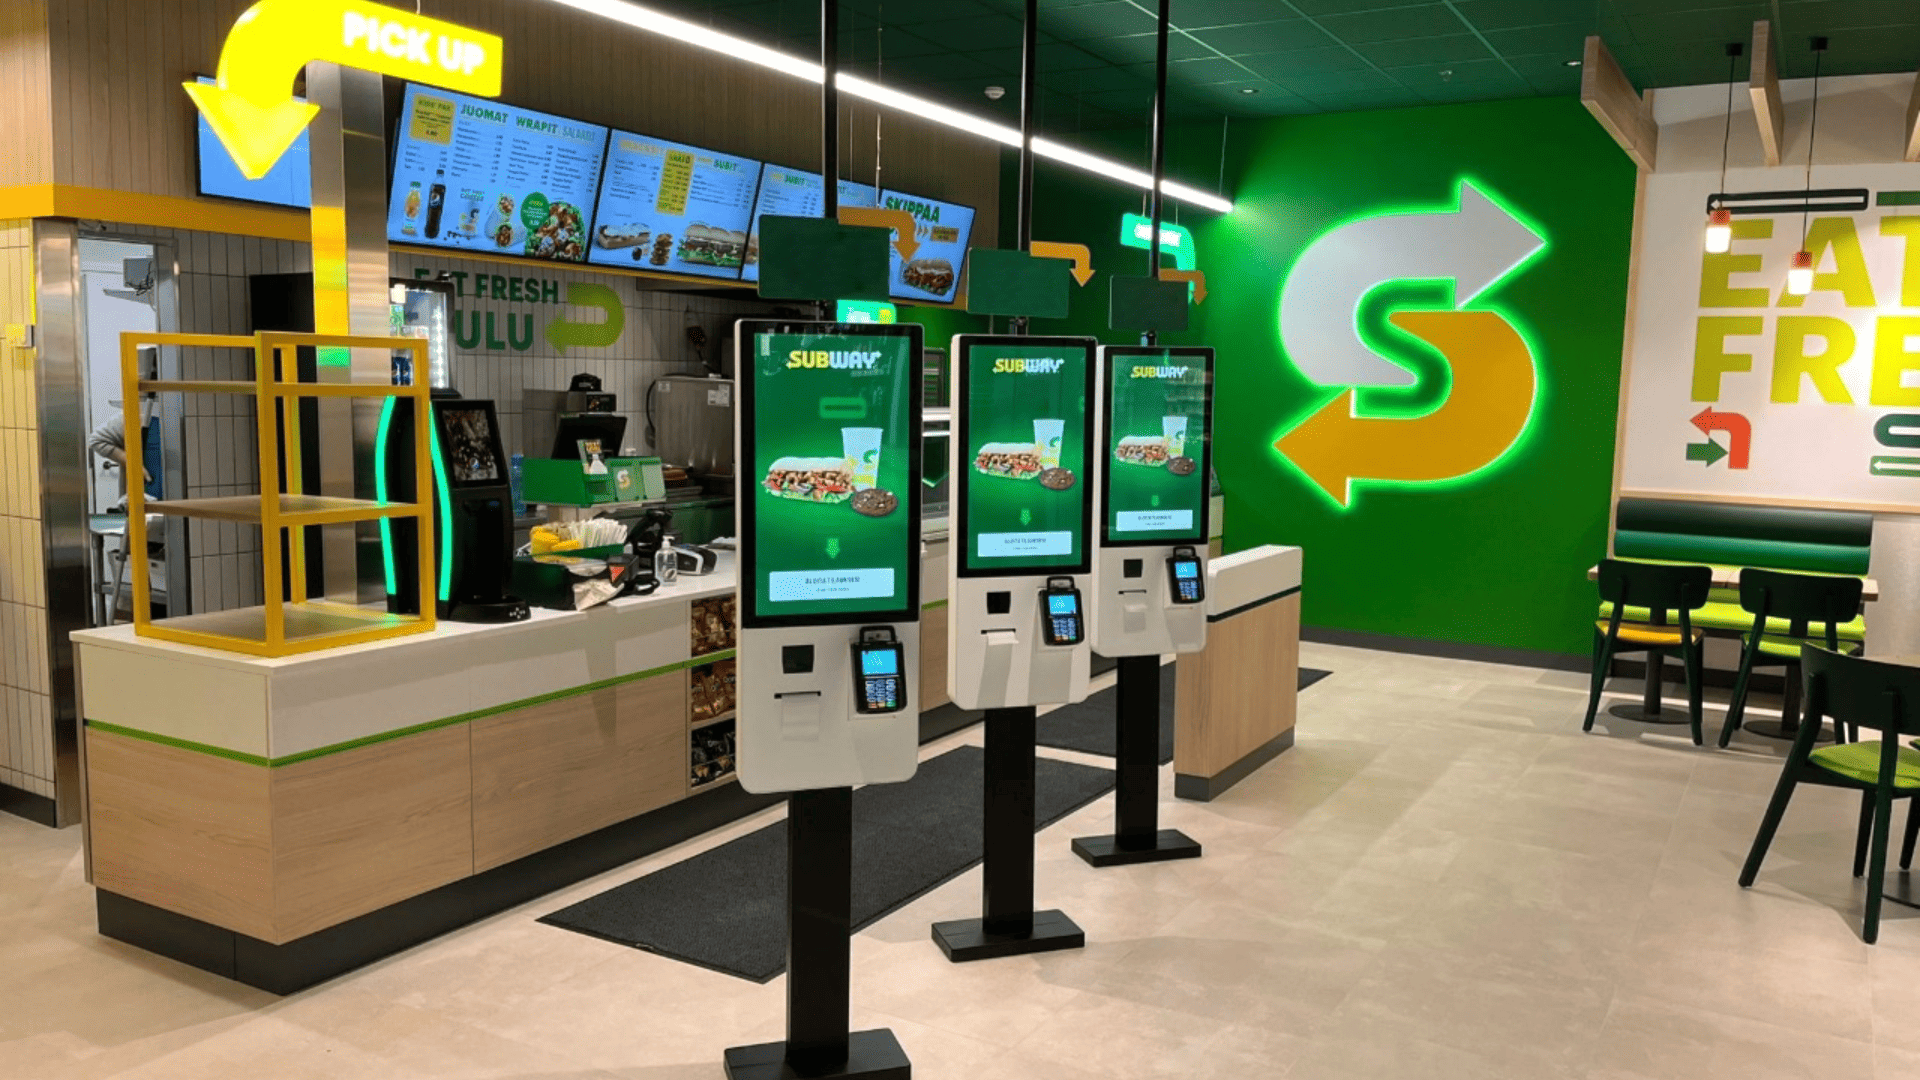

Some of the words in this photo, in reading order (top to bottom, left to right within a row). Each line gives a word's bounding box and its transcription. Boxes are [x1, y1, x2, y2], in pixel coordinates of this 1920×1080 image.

[343, 10, 432, 65] PICK
[437, 35, 487, 76] UP
[460, 103, 509, 124] JUOMAT
[516, 115, 558, 134] WRAPIT
[885, 195, 940, 223] SKIPPAA
[475, 272, 559, 305] FRESH
[455, 309, 534, 351] ULU
[786, 350, 882, 370] SUBWAY
[993, 357, 1064, 374] SUBWAY
[1130, 365, 1188, 379] SUBWAY
